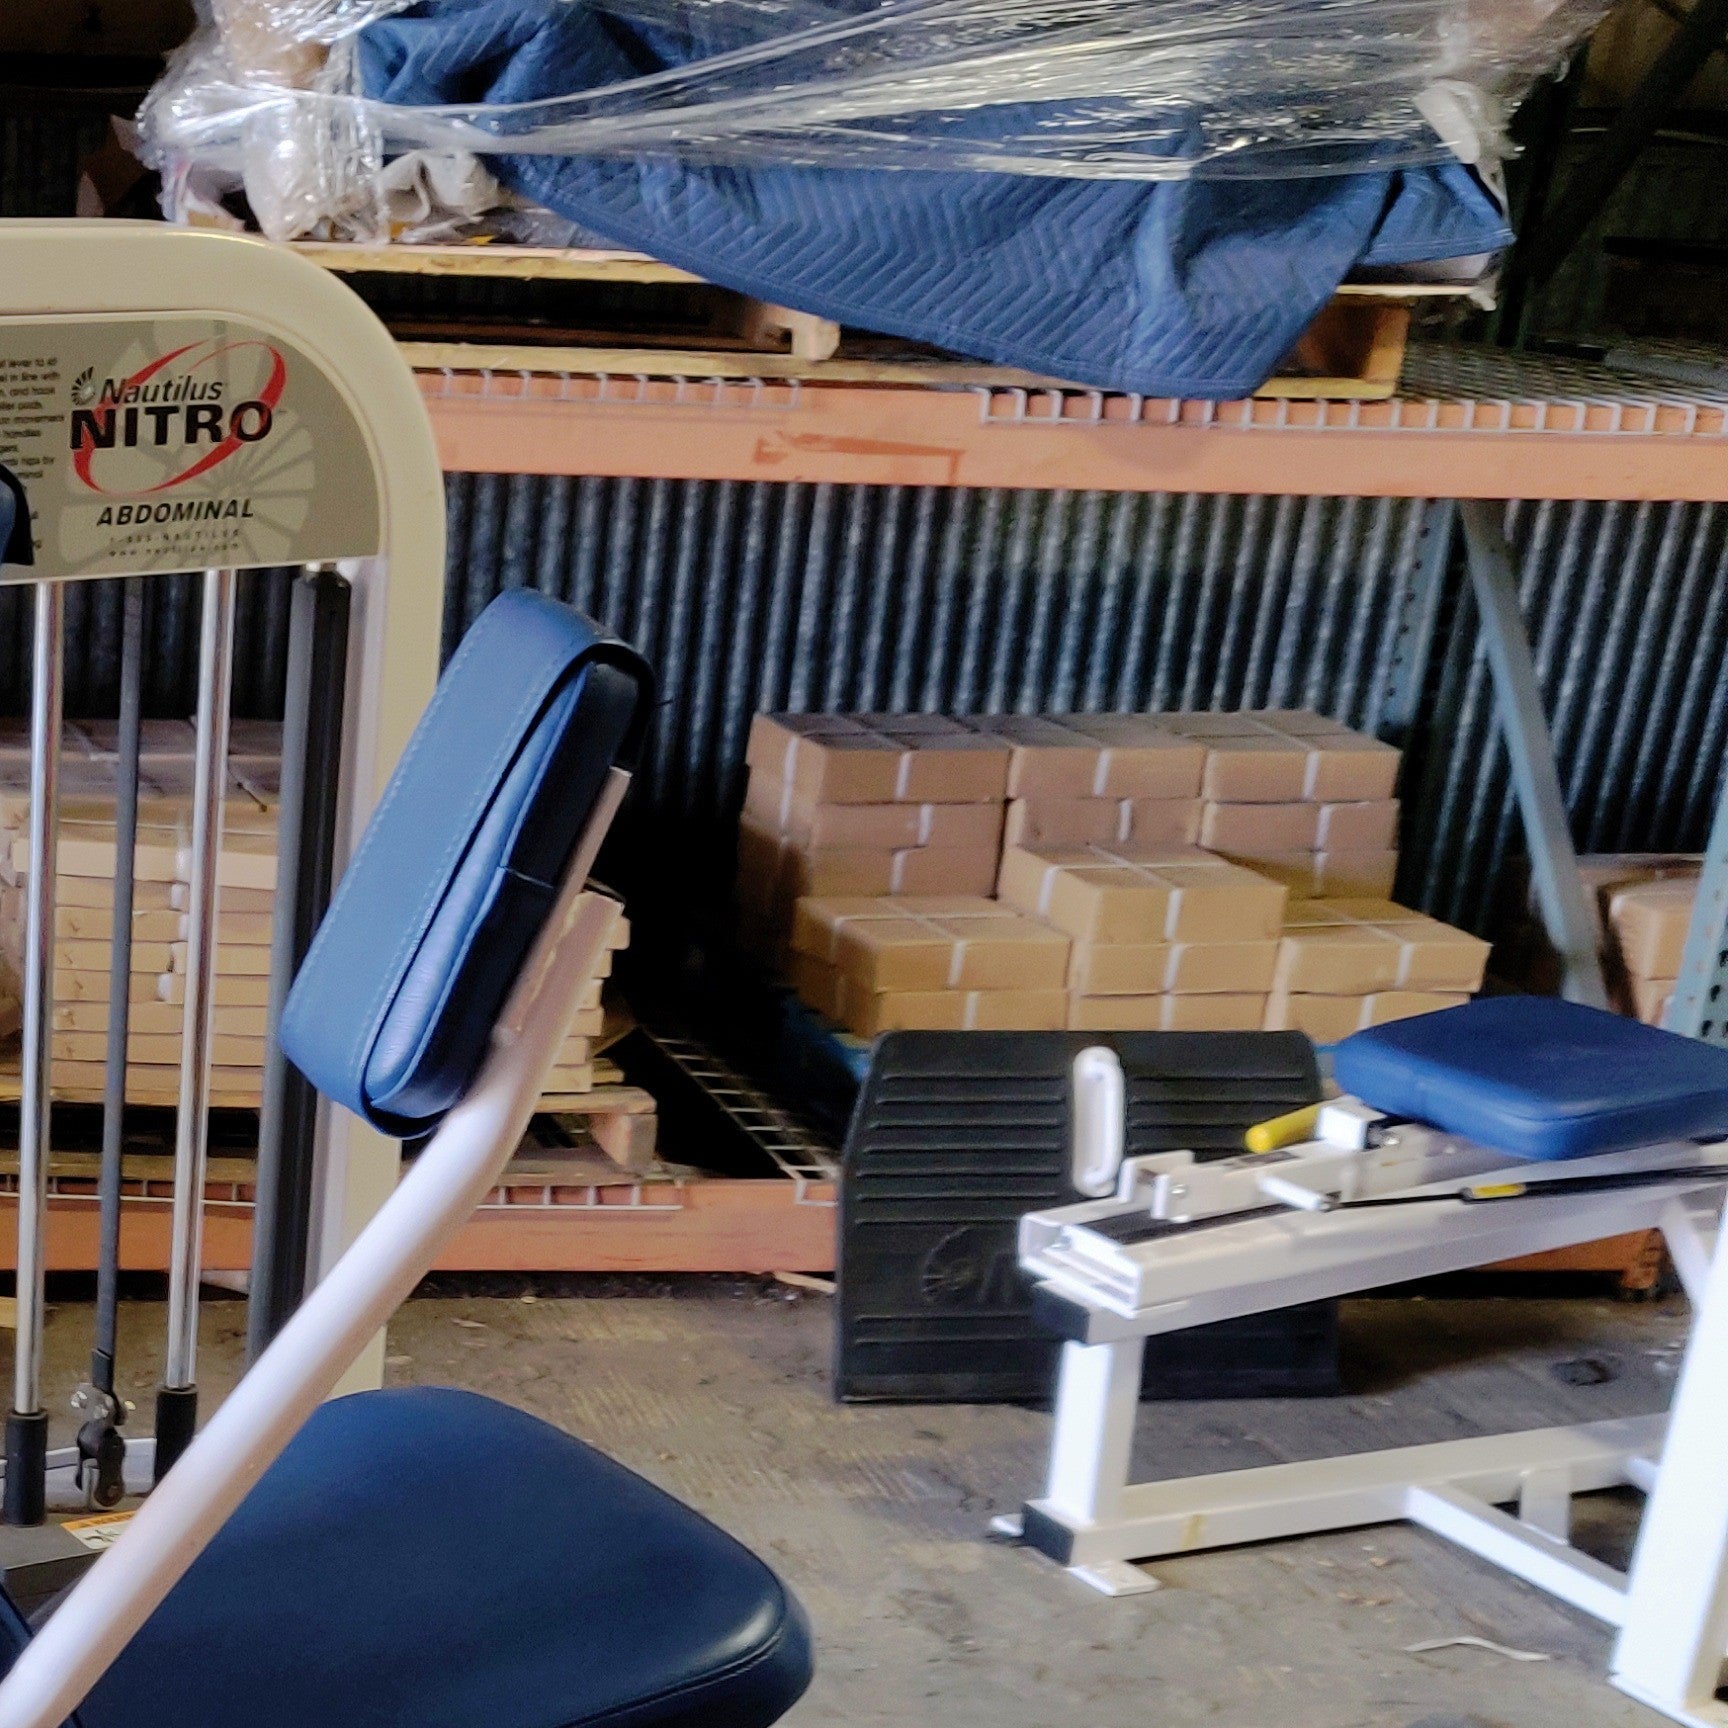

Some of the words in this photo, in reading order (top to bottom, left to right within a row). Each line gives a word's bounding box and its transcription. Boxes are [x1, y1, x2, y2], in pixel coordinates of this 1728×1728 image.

[100, 376, 223, 404] Nautilus
[70, 401, 273, 449] NITRO
[96, 498, 254, 527] ABDOMINAL
